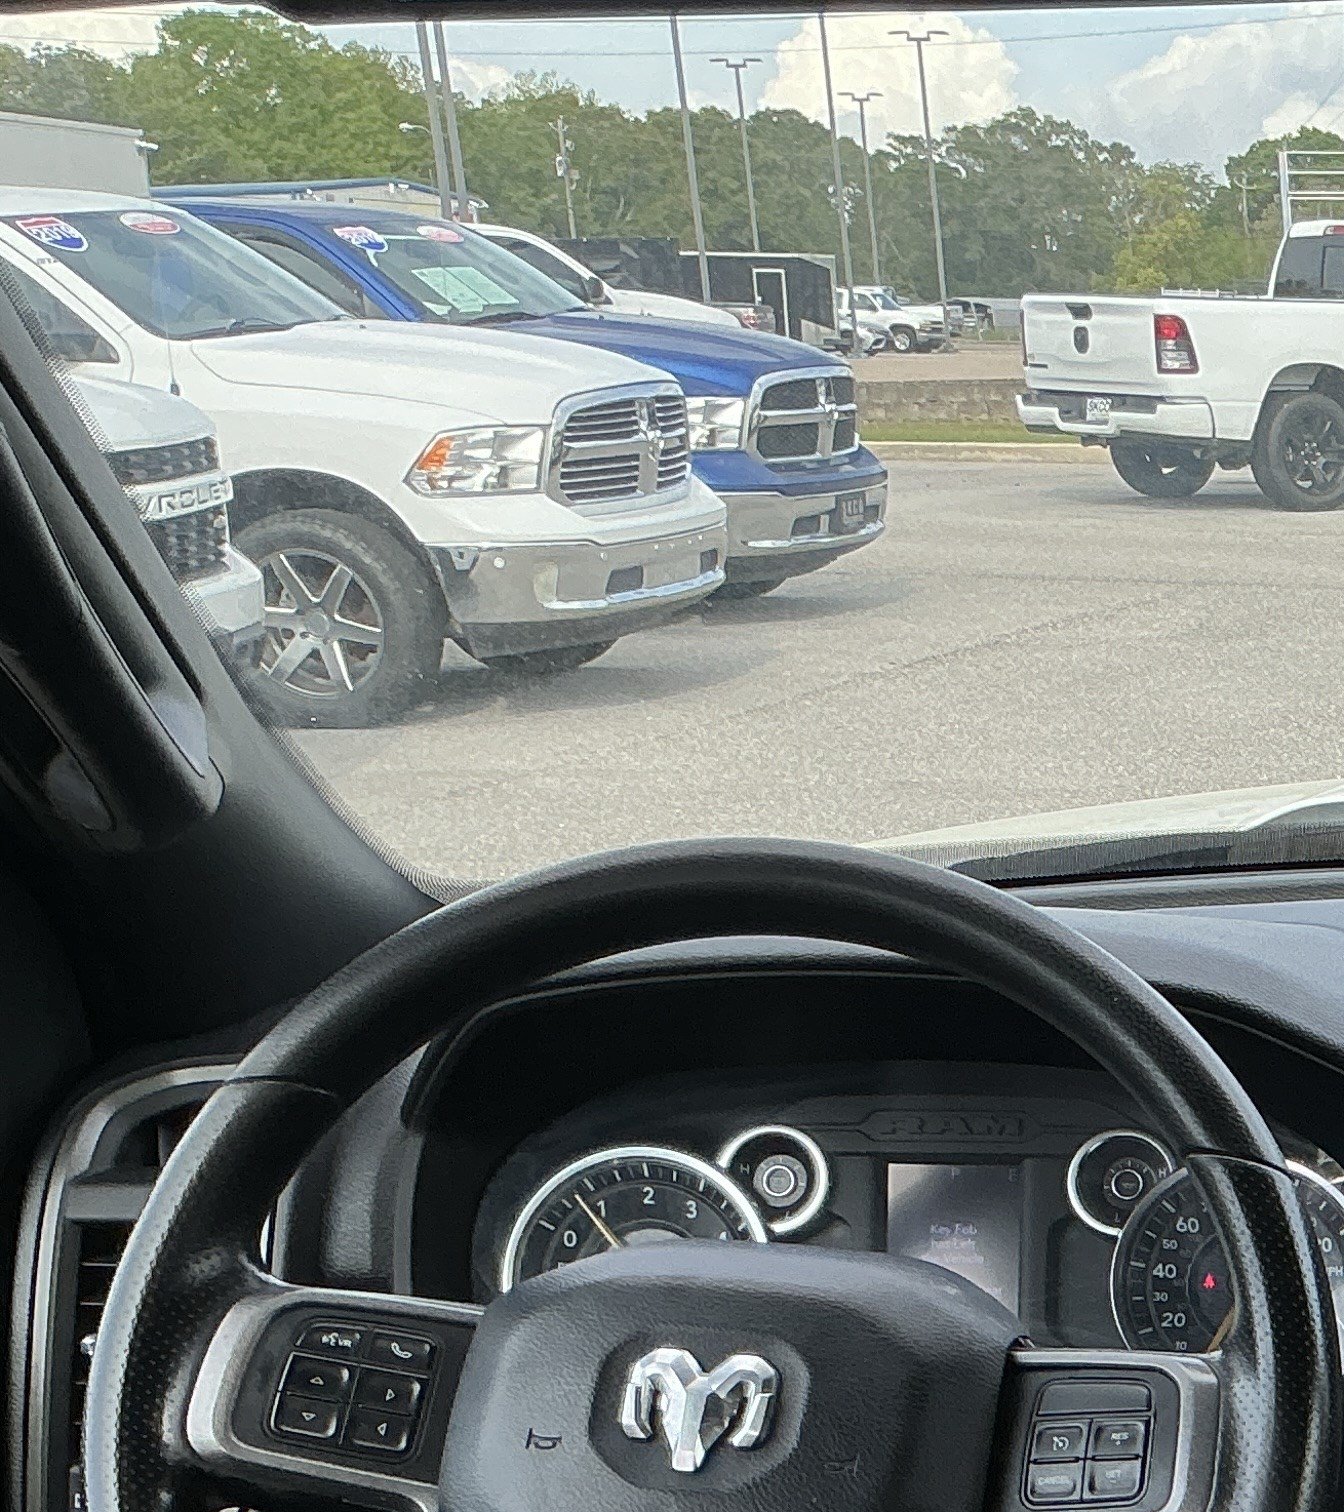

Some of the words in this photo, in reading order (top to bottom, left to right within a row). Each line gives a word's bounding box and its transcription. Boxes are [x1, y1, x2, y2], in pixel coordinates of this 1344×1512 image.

[878, 1115, 1023, 1137] RAM
[642, 1185, 657, 1206] 2
[597, 1200, 608, 1219] 1
[685, 1199, 699, 1220] 3
[1175, 1217, 1200, 1235] 60
[562, 1230, 579, 1248] 0
[1162, 1238, 1178, 1251] 50
[1152, 1263, 1177, 1280] 40
[1153, 1291, 1169, 1303] 30
[1160, 1312, 1186, 1329] 20
[1175, 1340, 1188, 1351] 10
[1110, 1431, 1130, 1441] RES
